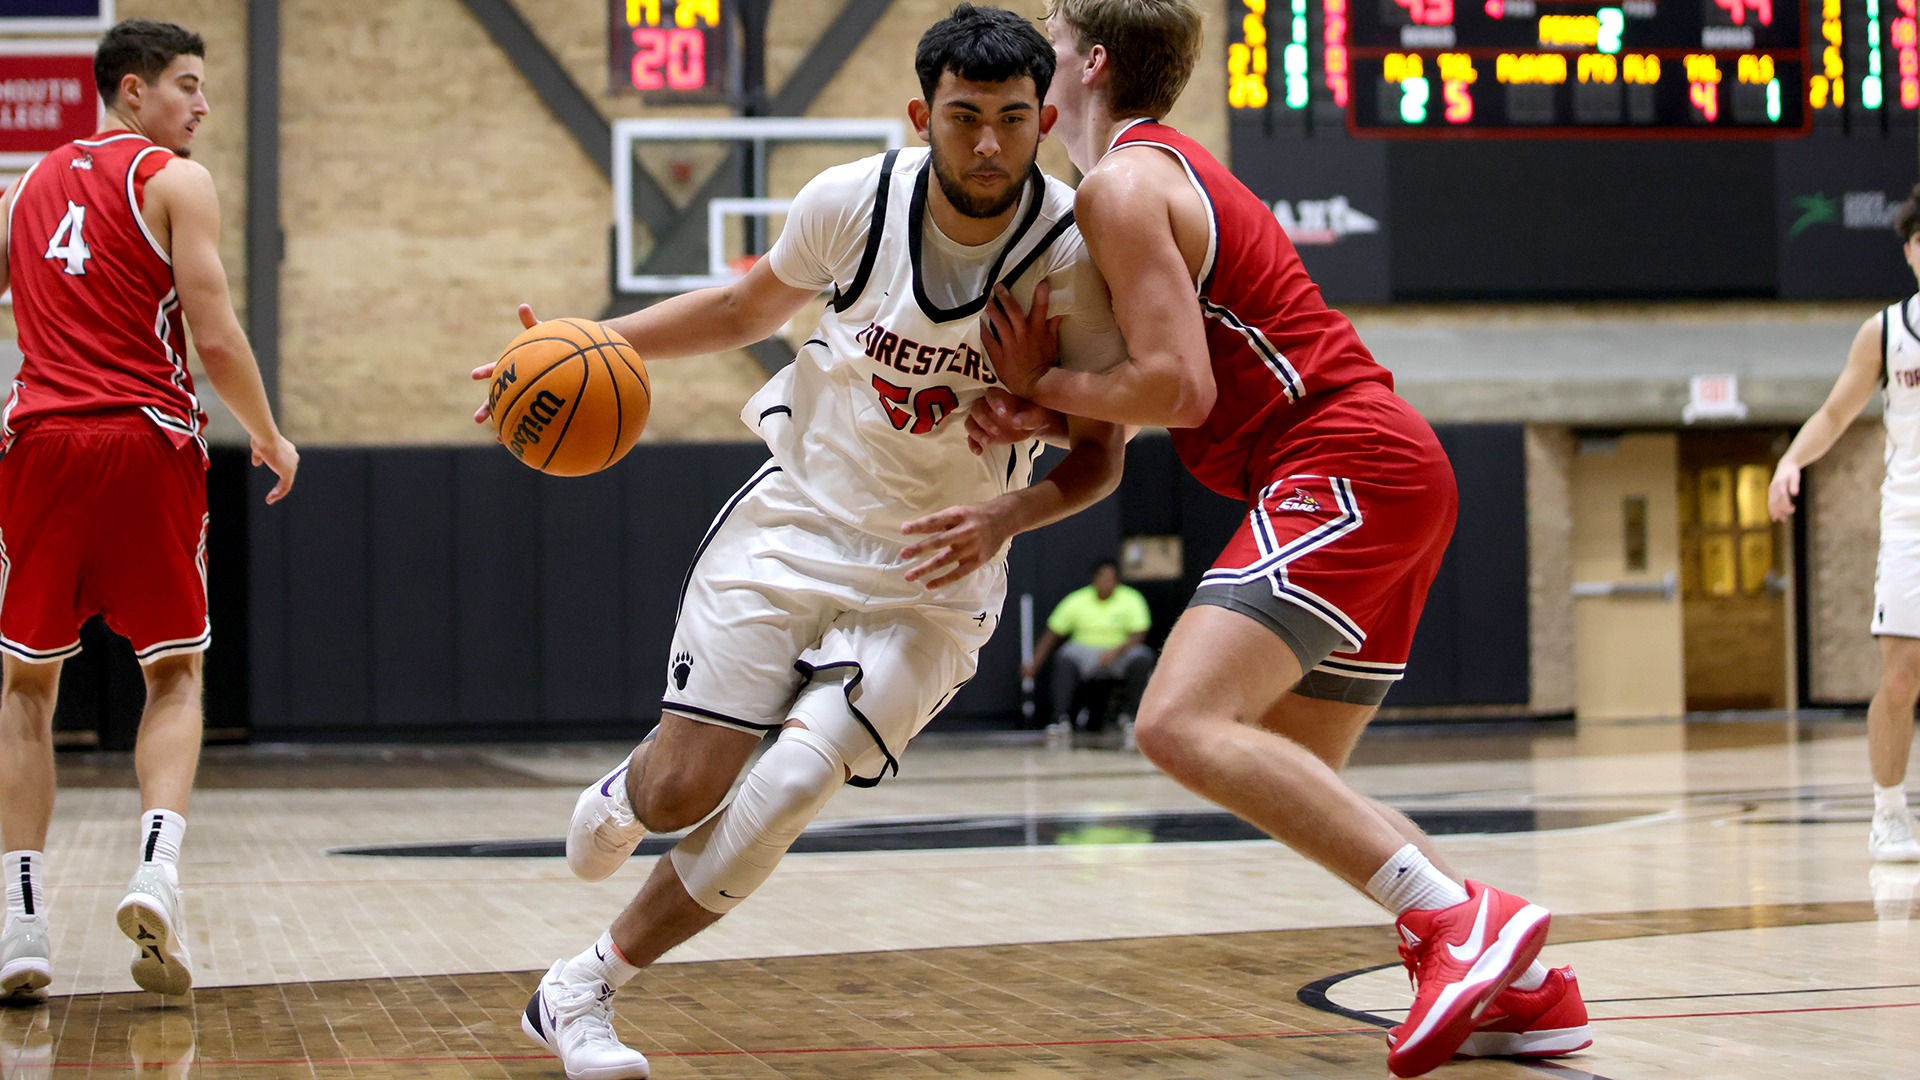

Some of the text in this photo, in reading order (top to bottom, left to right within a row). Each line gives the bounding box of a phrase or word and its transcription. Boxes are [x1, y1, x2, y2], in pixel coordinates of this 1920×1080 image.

[1596, 7, 1624, 54] 2
[631, 28, 706, 90] 20
[1401, 76, 1473, 123] 2 5
[1689, 77, 1781, 122] 4 1
[44, 200, 91, 275] 4
